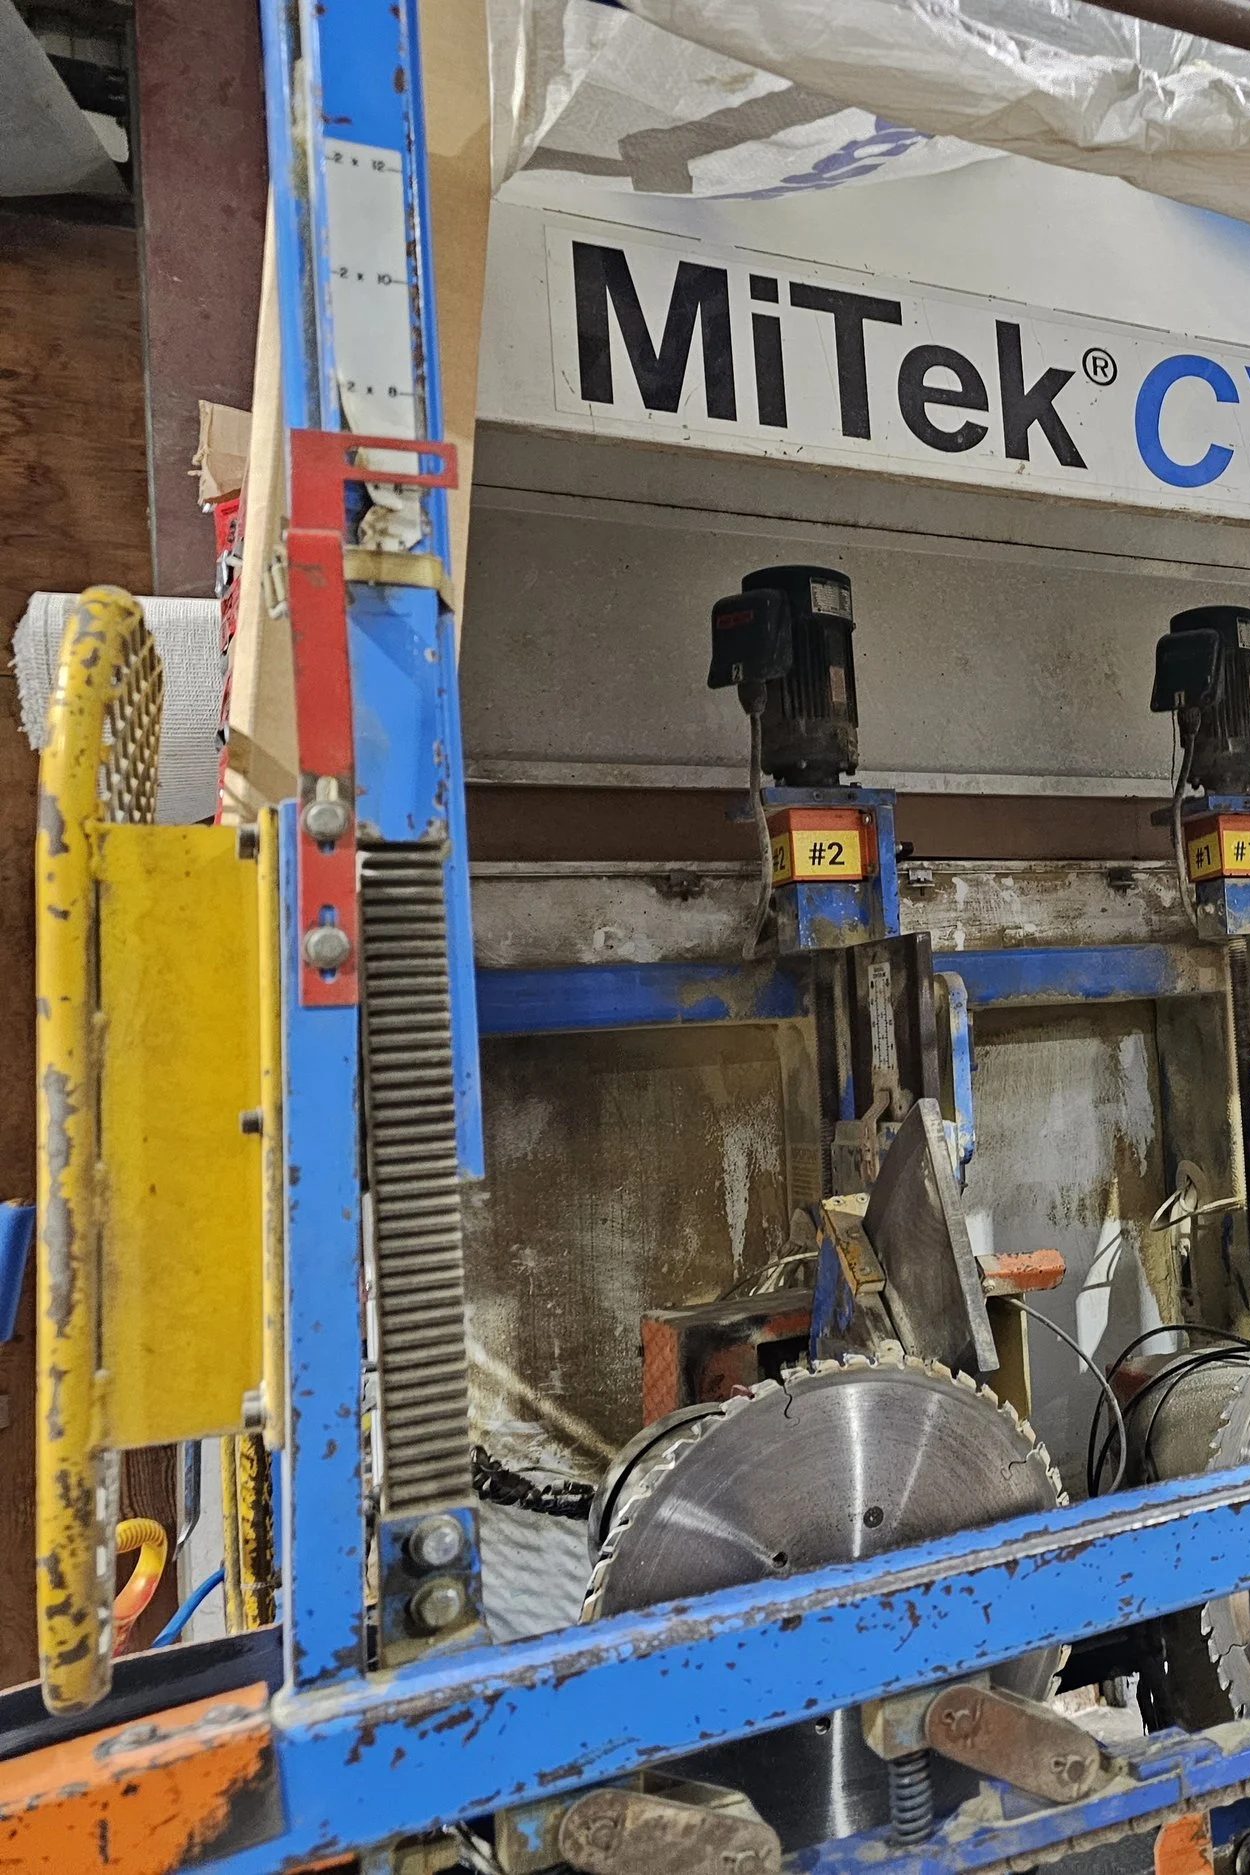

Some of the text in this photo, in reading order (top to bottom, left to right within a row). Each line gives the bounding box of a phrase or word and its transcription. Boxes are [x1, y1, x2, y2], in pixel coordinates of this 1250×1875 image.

[334, 152, 343, 164] 2
[372, 159, 386, 172] 12
[339, 267, 348, 279] 2
[377, 273, 392, 285] 10
[347, 381, 356, 393] 2
[772, 846, 786, 872] #2
[808, 842, 845, 866] #2
[1195, 845, 1211, 869] #1
